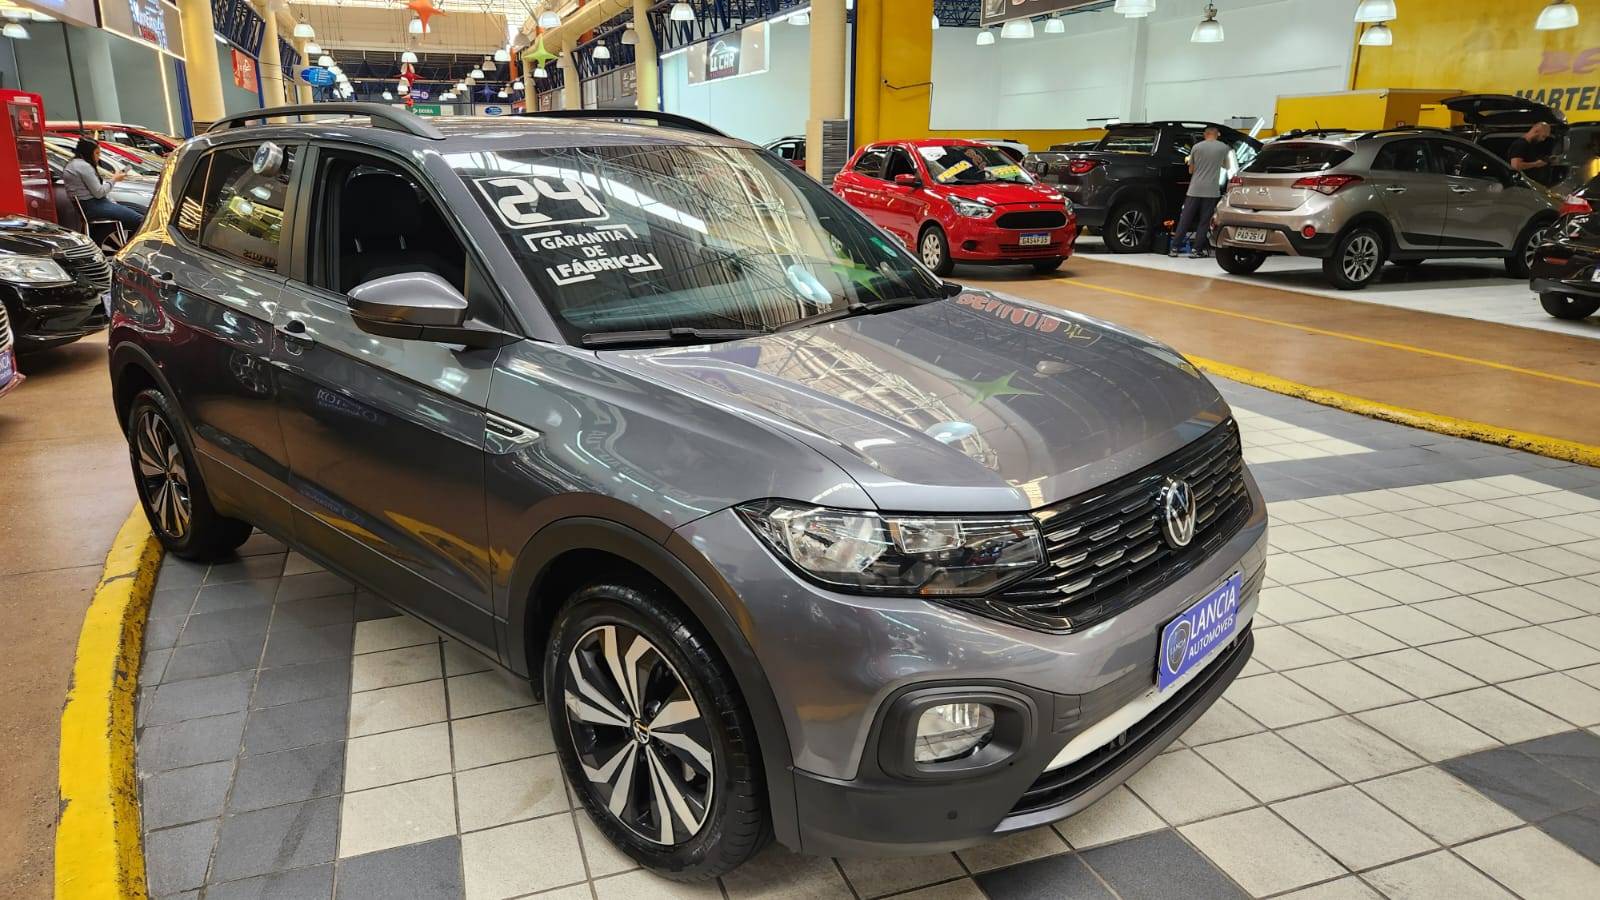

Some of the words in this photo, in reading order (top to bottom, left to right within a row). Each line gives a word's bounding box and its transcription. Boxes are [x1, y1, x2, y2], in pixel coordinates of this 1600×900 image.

[719, 51, 735, 70] CAR
[488, 178, 600, 224] 24
[540, 229, 628, 250] GARANTIA
[581, 245, 608, 258] DE
[556, 253, 650, 279] FÁBRICA
[1190, 585, 1236, 640] LANCIA
